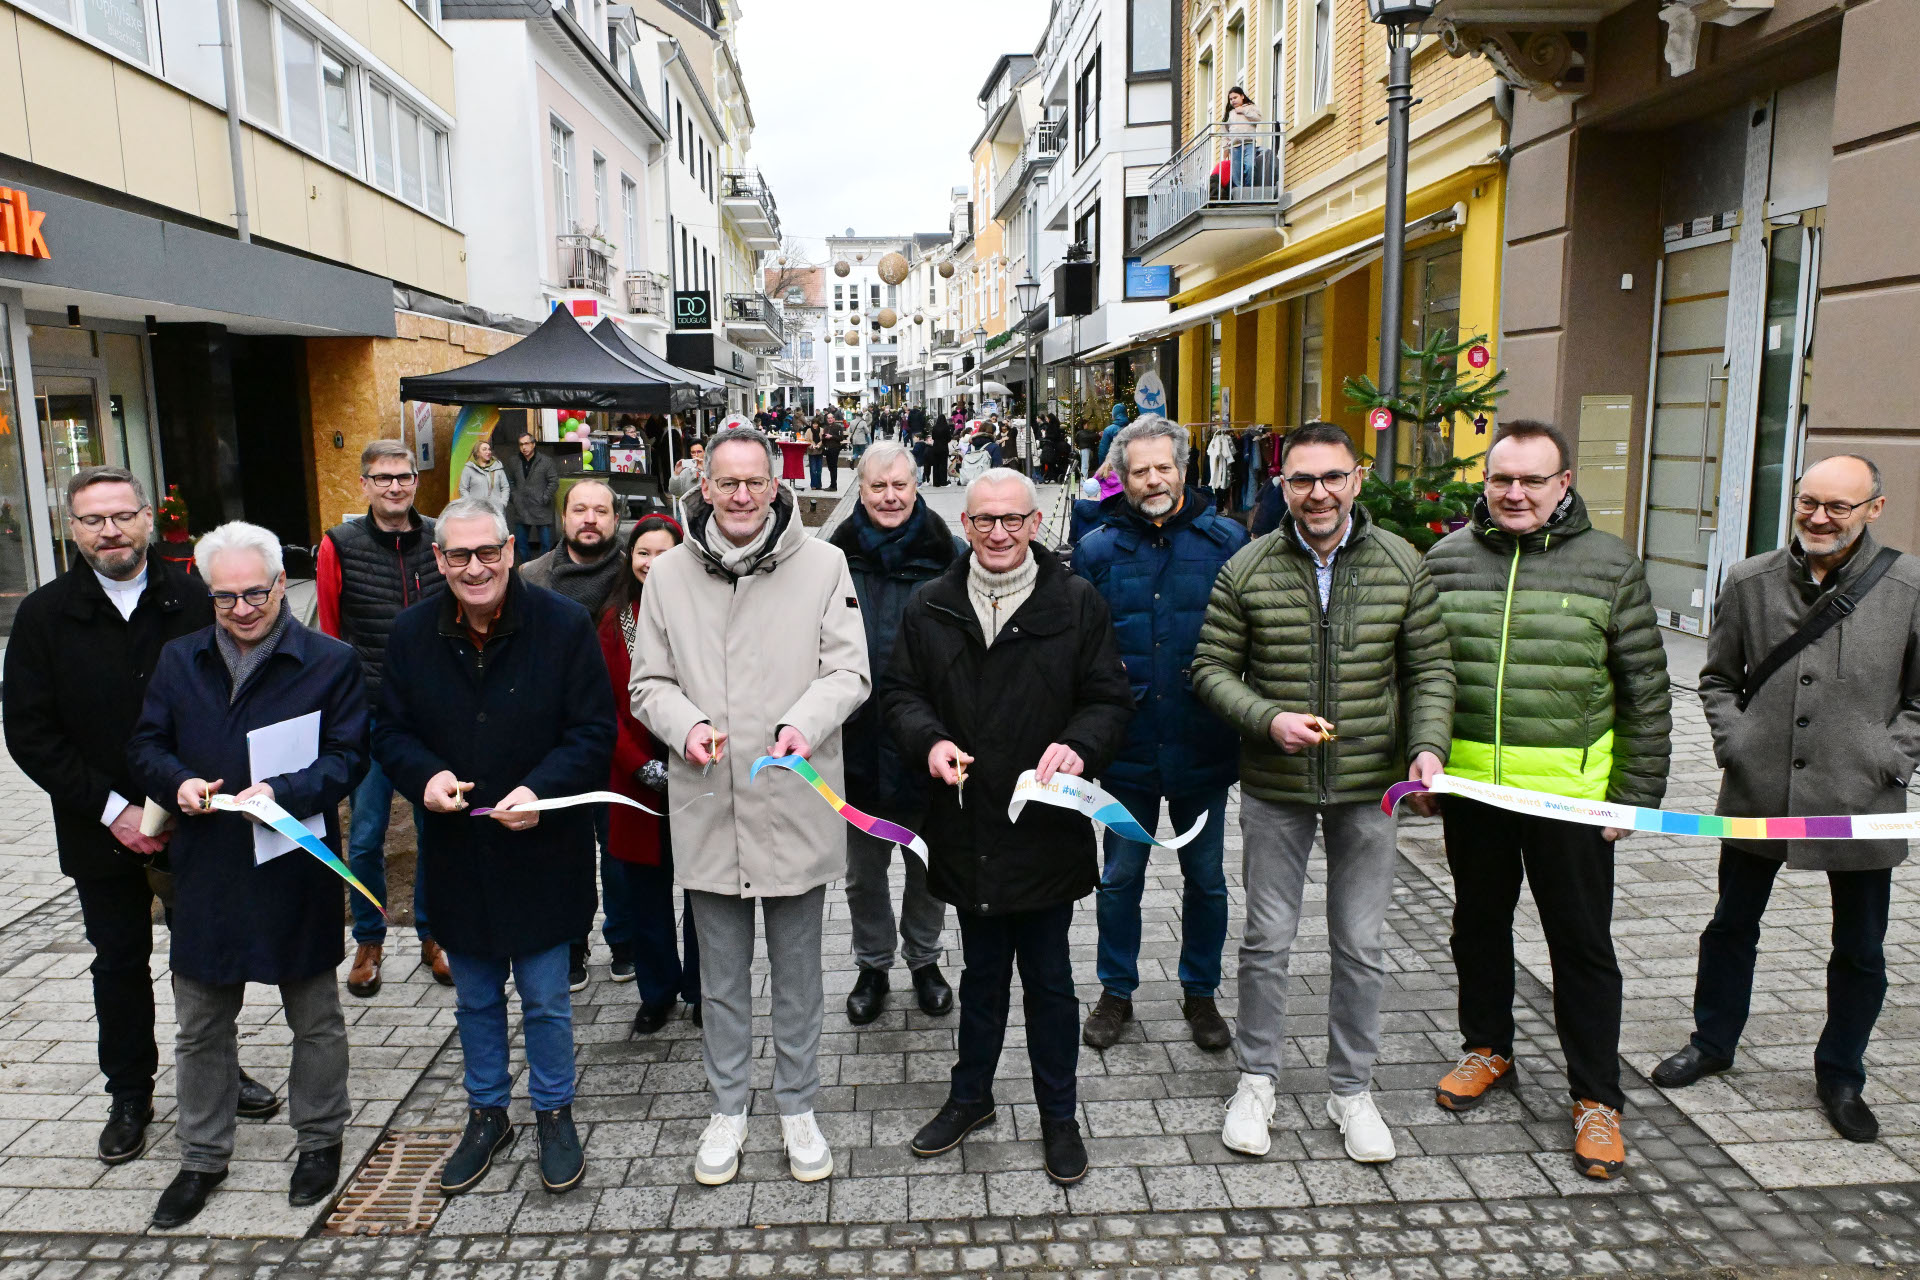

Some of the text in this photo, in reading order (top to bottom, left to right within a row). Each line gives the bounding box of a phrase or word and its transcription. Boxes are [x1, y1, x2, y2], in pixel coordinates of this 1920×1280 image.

[0, 186, 51, 260] ik
[1486, 790, 1514, 804] Stadt
[1517, 796, 1542, 809] wird
[1868, 821, 1914, 831] Unsere
